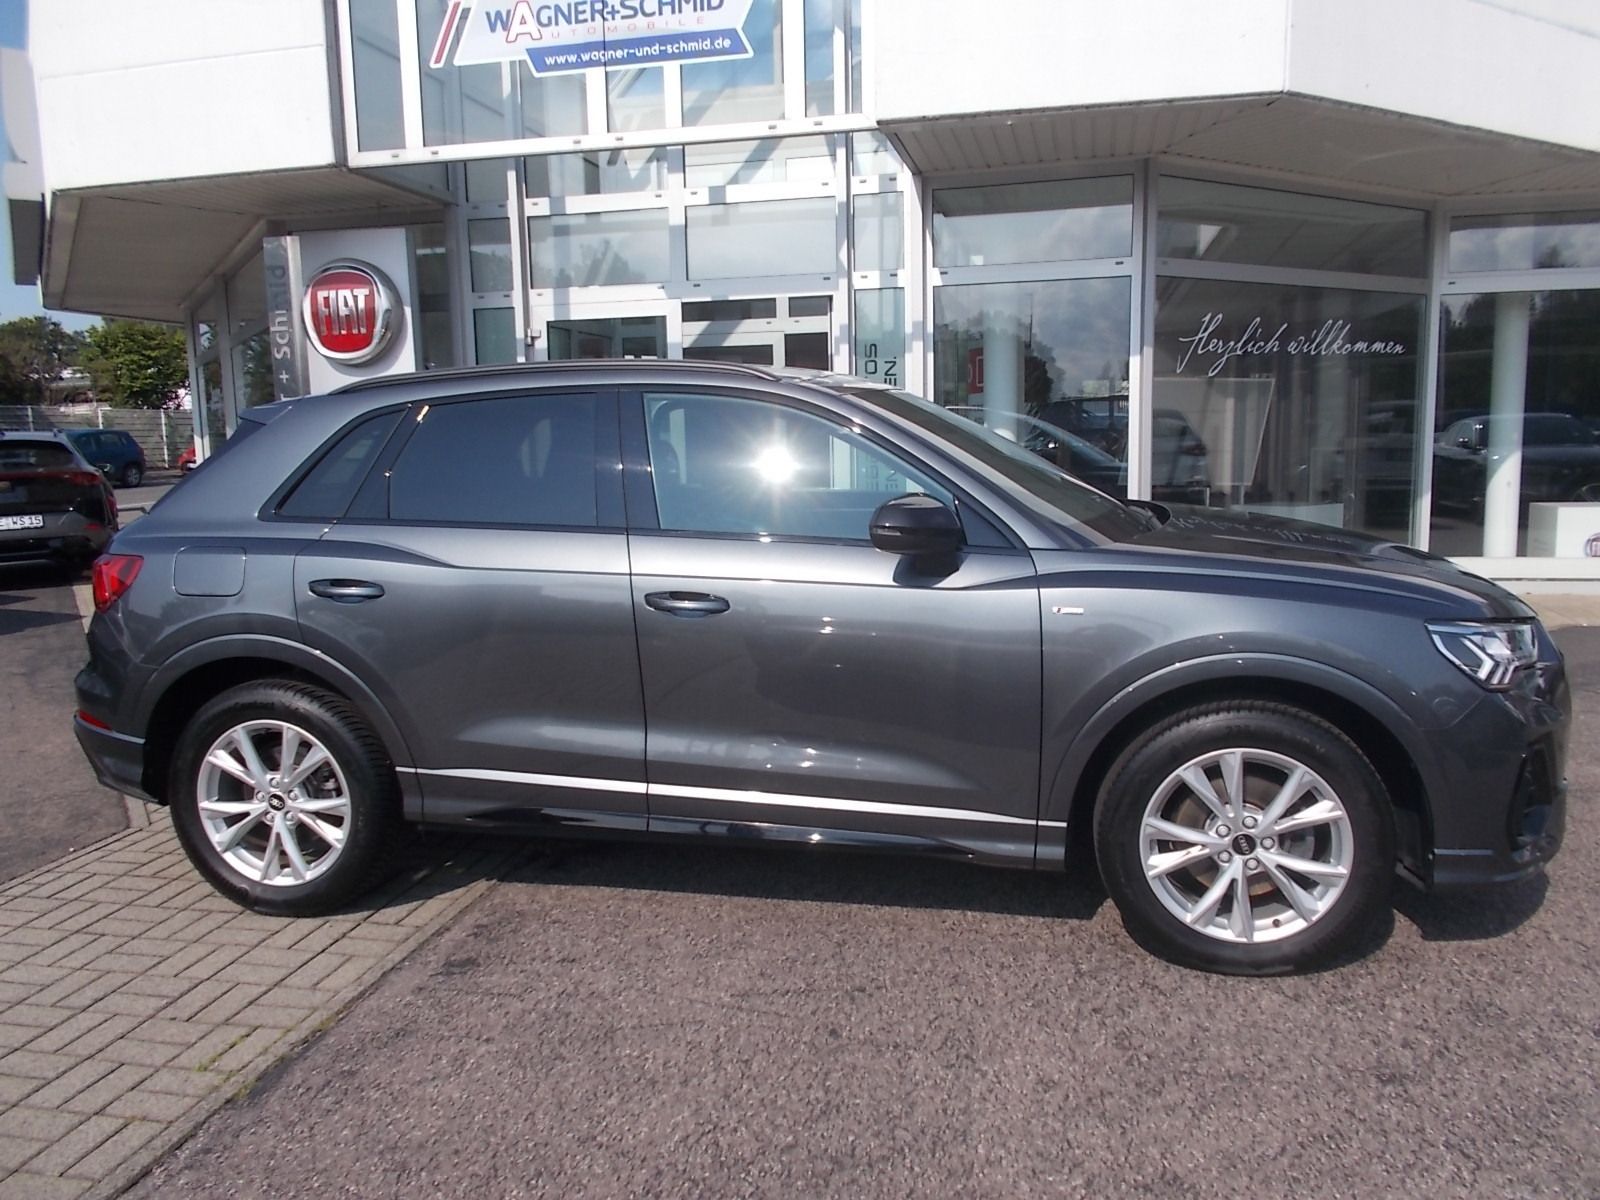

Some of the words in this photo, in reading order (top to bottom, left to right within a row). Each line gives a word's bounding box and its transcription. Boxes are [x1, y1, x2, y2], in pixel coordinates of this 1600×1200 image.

[544, 36, 731, 67] www.wagner-und-schmid.de
[316, 287, 370, 337] FIAT
[1176, 312, 1288, 377] Herzlich
[1287, 319, 1406, 356] willkommen
